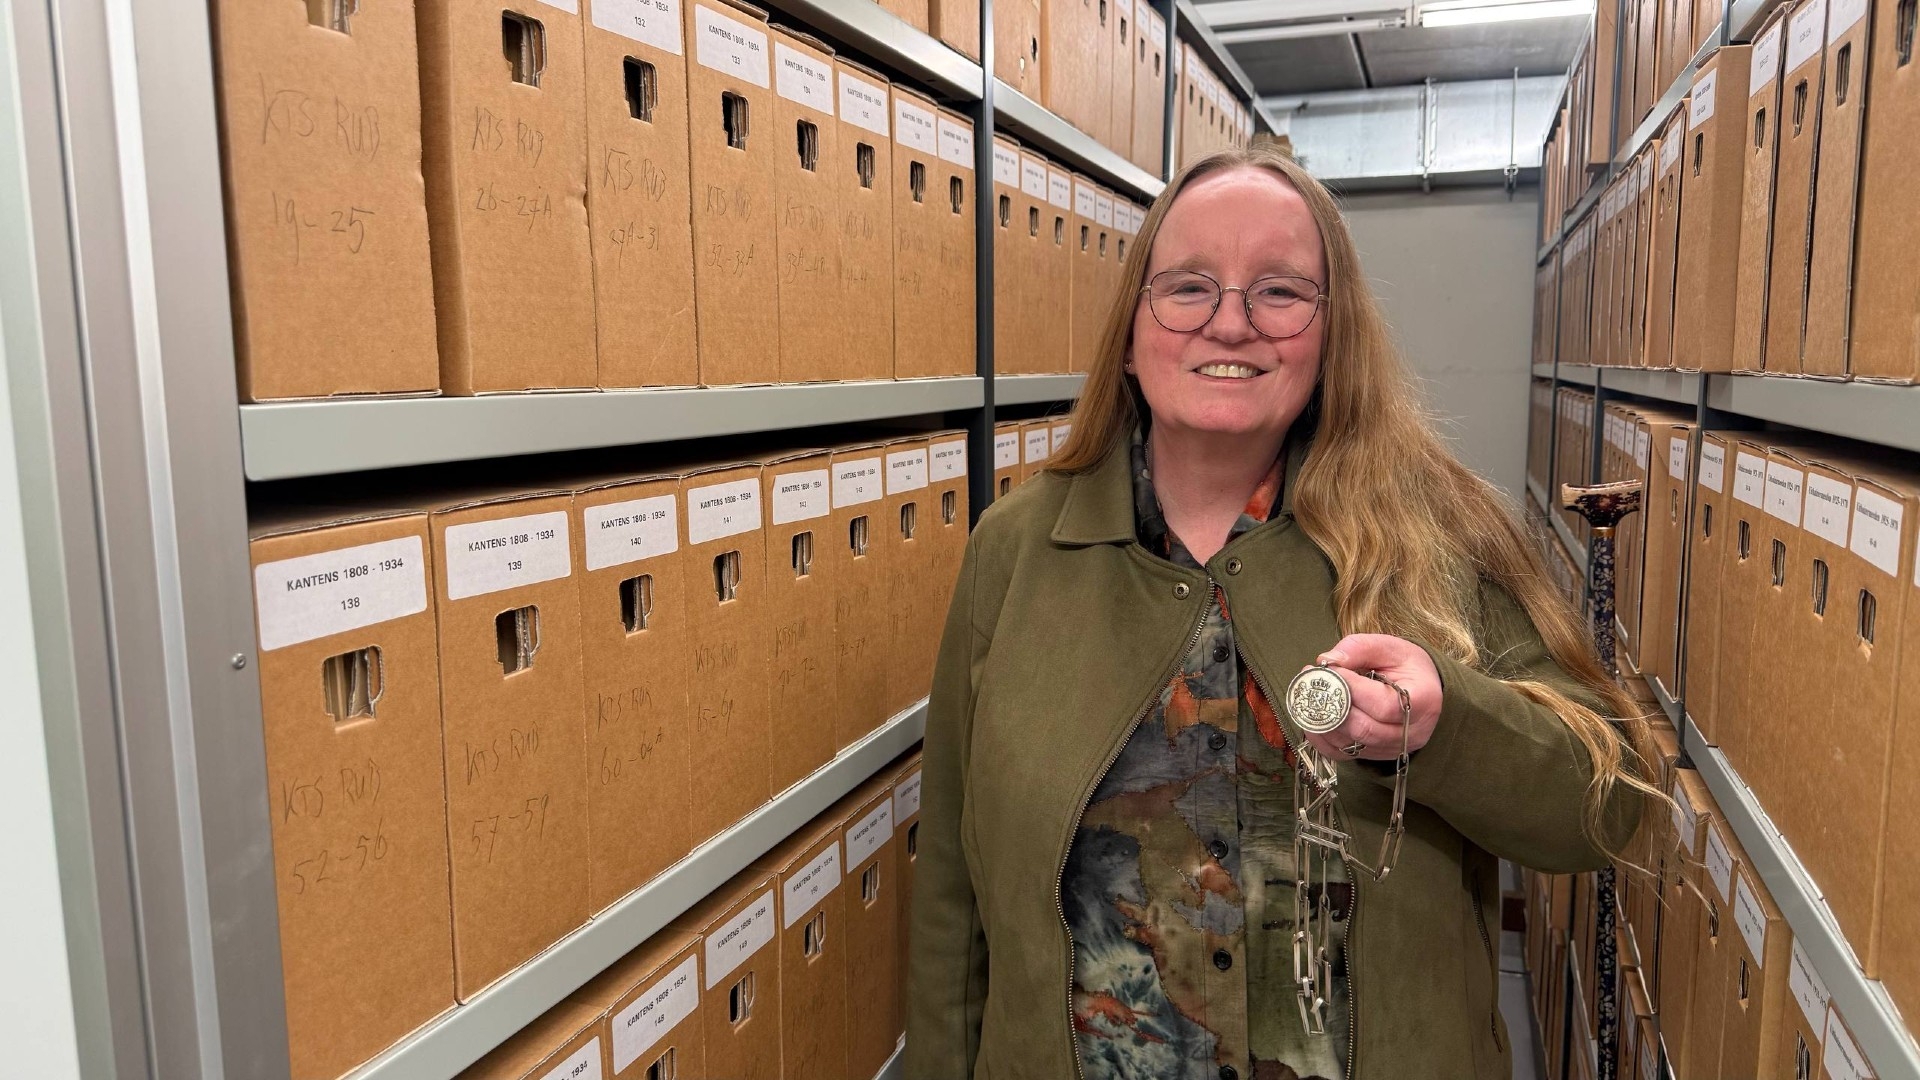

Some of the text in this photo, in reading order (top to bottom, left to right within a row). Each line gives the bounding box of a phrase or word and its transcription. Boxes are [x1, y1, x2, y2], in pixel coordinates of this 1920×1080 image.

[655, 1, 669, 12] 1934
[634, 16, 646, 28] 132
[708, 24, 732, 41] KANTENS
[732, 34, 745, 46] 1808
[748, 41, 760, 52] 1934
[731, 55, 741, 65] 133
[784, 58, 803, 73] KANTENS
[258, 72, 315, 145] KTS
[472, 106, 504, 152] KTS
[603, 143, 634, 195] KTS
[706, 184, 727, 217] KTS
[840, 470, 857, 480] KANTENS
[782, 484, 801, 494] KANTENS
[700, 497, 724, 509] KANTENS
[724, 494, 737, 505] 1808
[740, 492, 752, 502] 1934
[601, 516, 631, 530] KANTENS
[632, 513, 647, 524] 1808
[652, 510, 666, 520] 1934
[723, 516, 732, 524] 141
[468, 537, 507, 552] KANTENS
[510, 533, 529, 545] 1808
[536, 529, 555, 541] 1934
[630, 536, 642, 546] 140
[287, 571, 339, 591] KANTENS
[343, 565, 369, 579] 1808
[379, 558, 404, 572] 1934
[508, 560, 522, 571] 139
[341, 597, 361, 610] 138
[598, 692, 622, 733] KTS
[465, 738, 500, 786] KTS
[282, 775, 324, 824] KTS
[793, 873, 811, 892] KANTENS
[717, 928, 740, 950] KANTENS
[740, 917, 752, 931] 1808
[755, 906, 766, 919] 1934
[738, 940, 748, 951] 149
[626, 1001, 654, 1028] KANTENS
[655, 988, 670, 1005] 1808
[673, 974, 687, 989] 1934
[654, 1013, 665, 1027] 148
[571, 1060, 588, 1078] 1934
